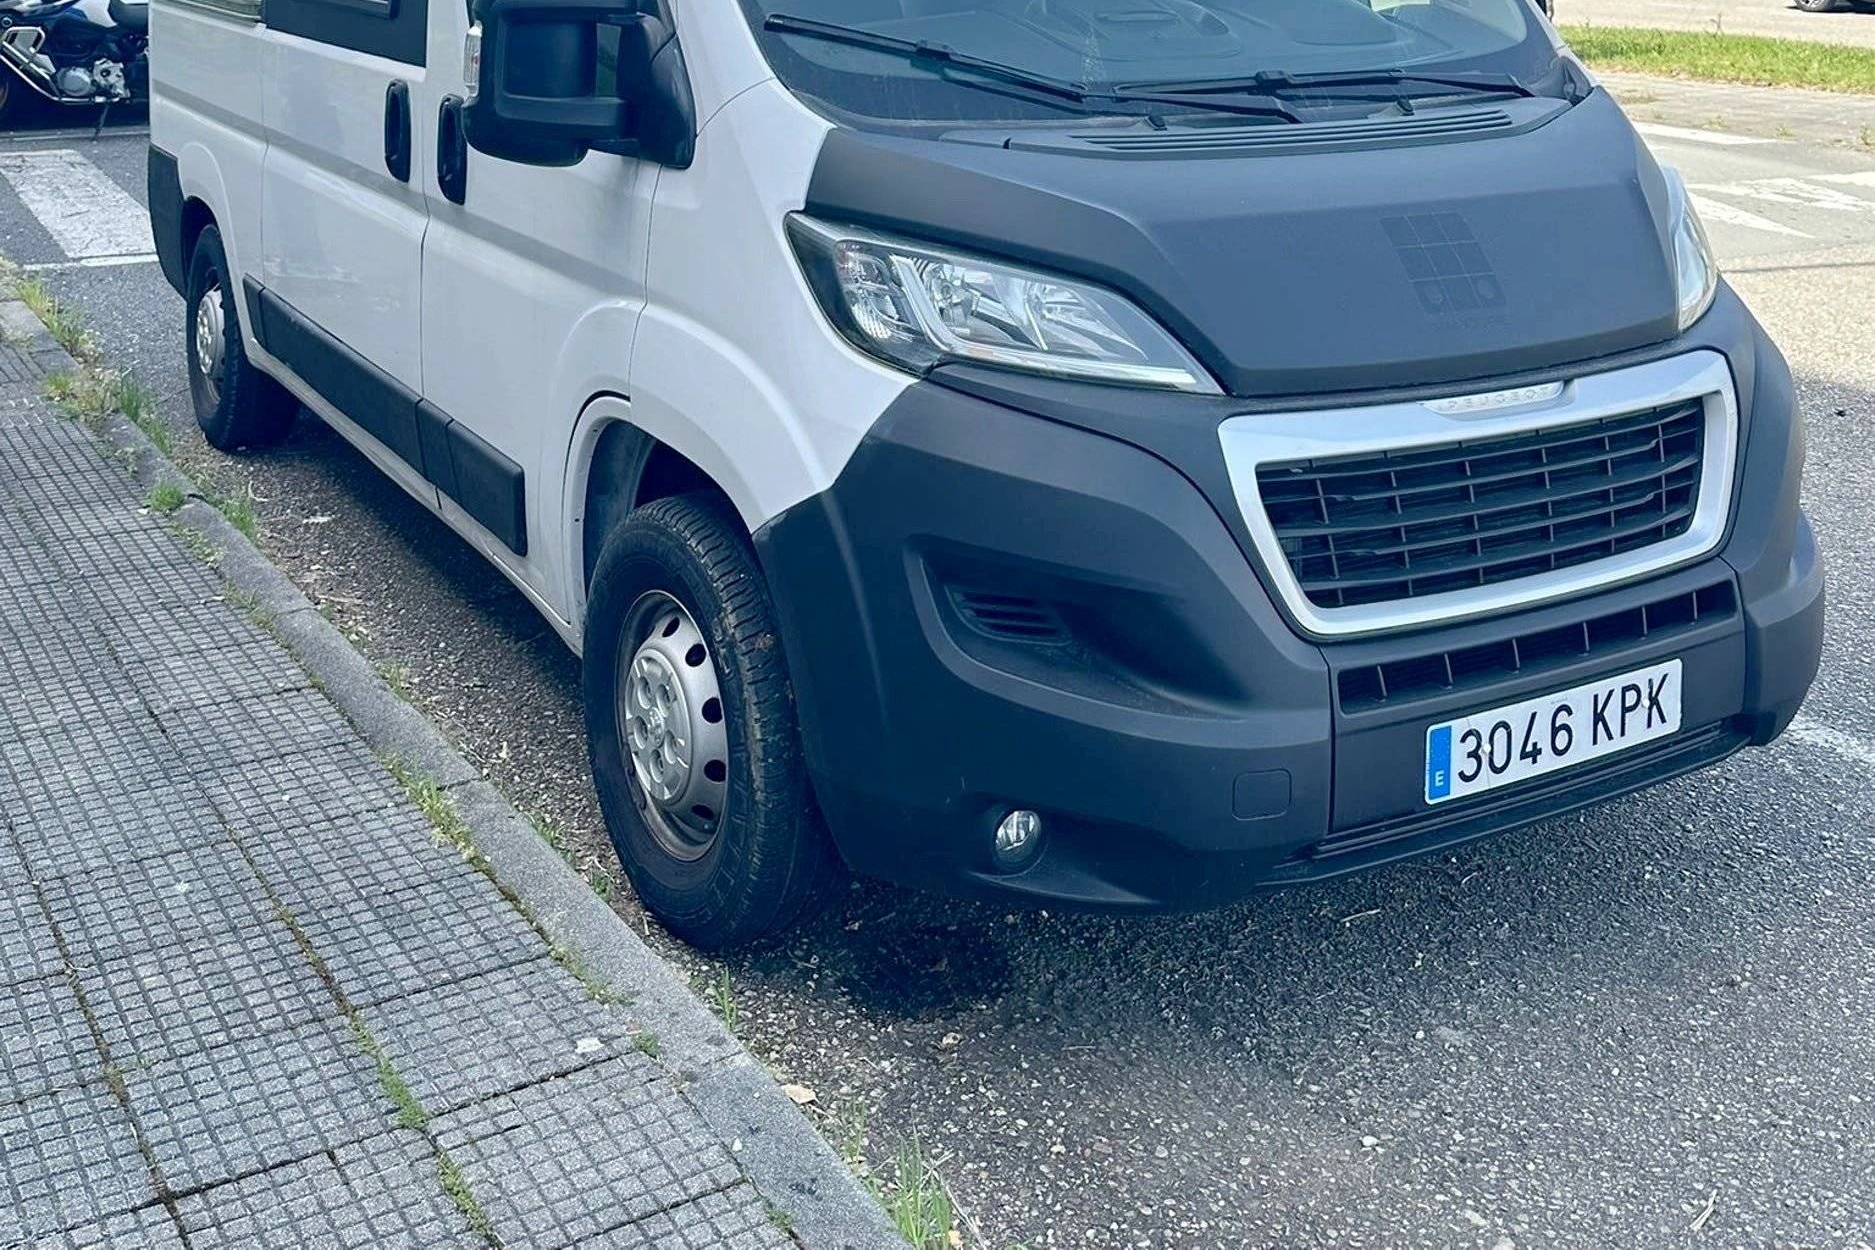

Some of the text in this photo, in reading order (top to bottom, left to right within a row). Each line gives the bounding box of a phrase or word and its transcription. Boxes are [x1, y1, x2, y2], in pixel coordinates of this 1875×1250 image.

[1458, 673, 1669, 782] 3046 KPK
[1434, 769, 1445, 787] E
